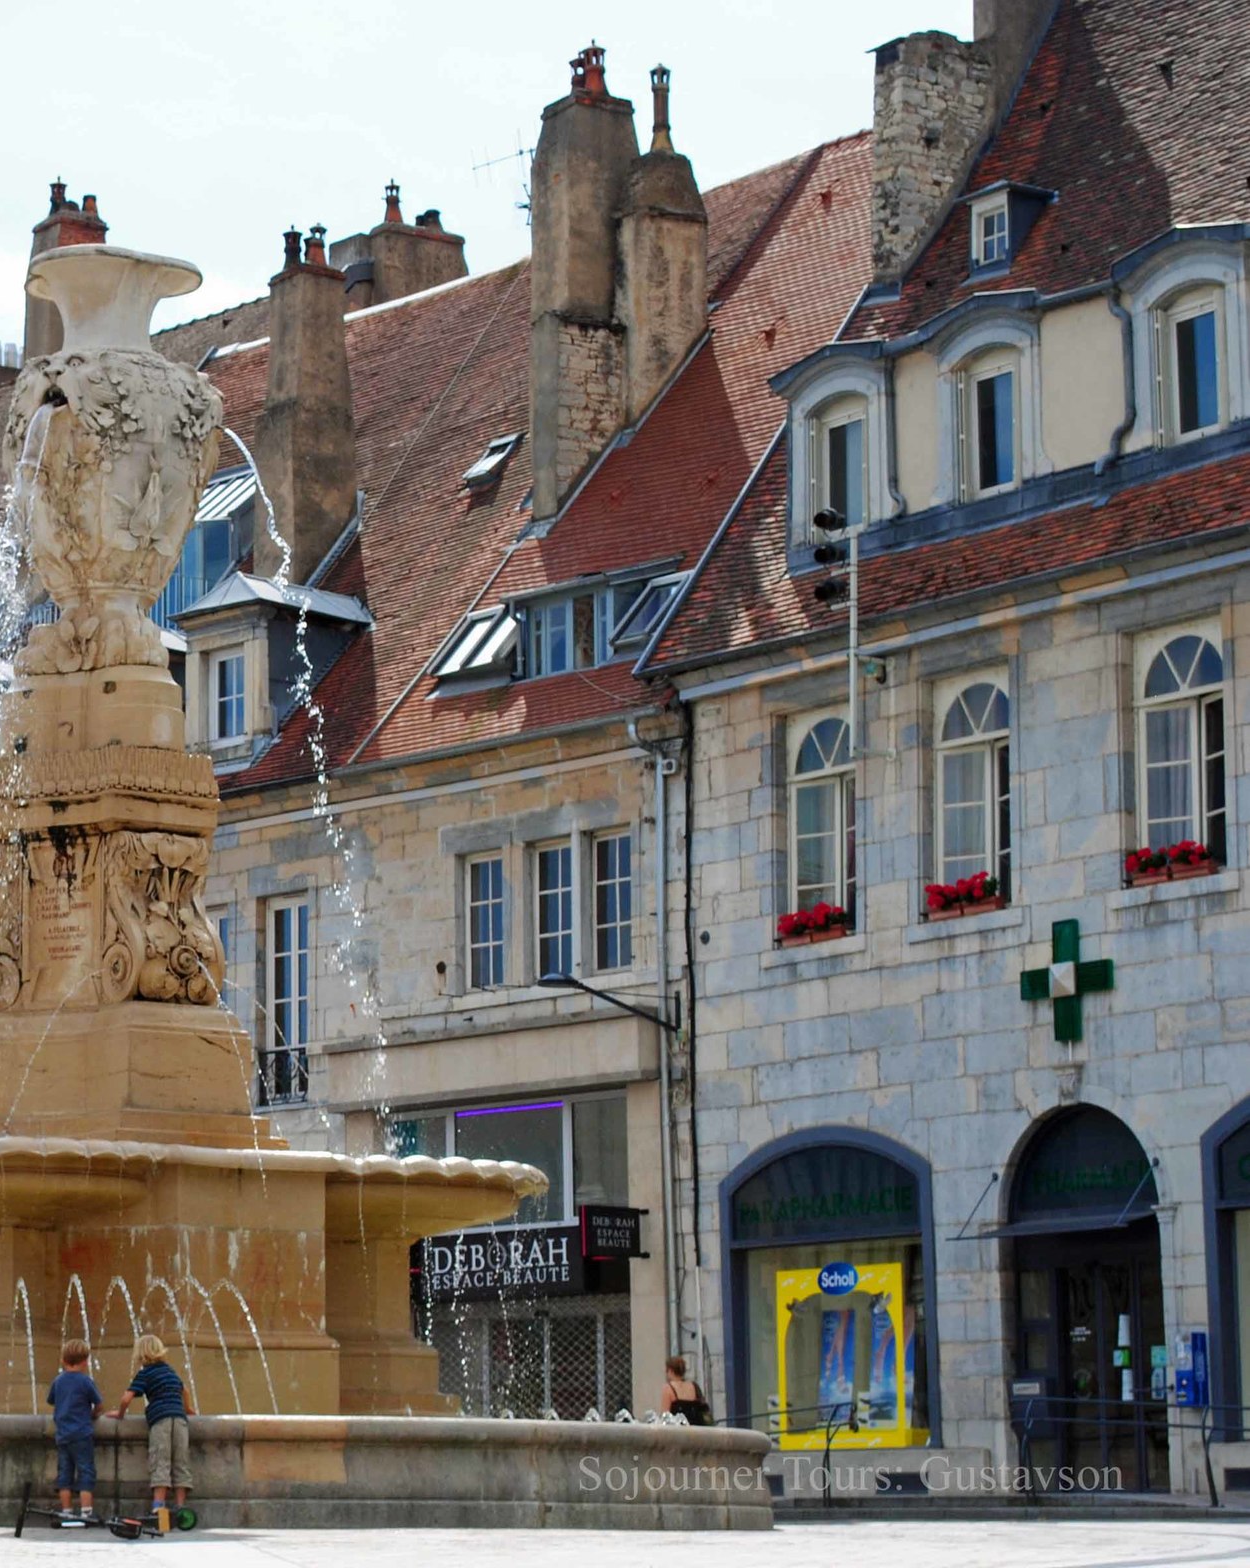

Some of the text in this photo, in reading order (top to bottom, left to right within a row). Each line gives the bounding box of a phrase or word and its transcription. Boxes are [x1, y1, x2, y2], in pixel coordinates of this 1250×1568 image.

[597, 1228, 630, 1239] ESPACE
[433, 1237, 569, 1275] DEBORAH
[432, 1266, 570, 1290] ESPACE BEAUTE
[821, 1271, 856, 1289] Scholl
